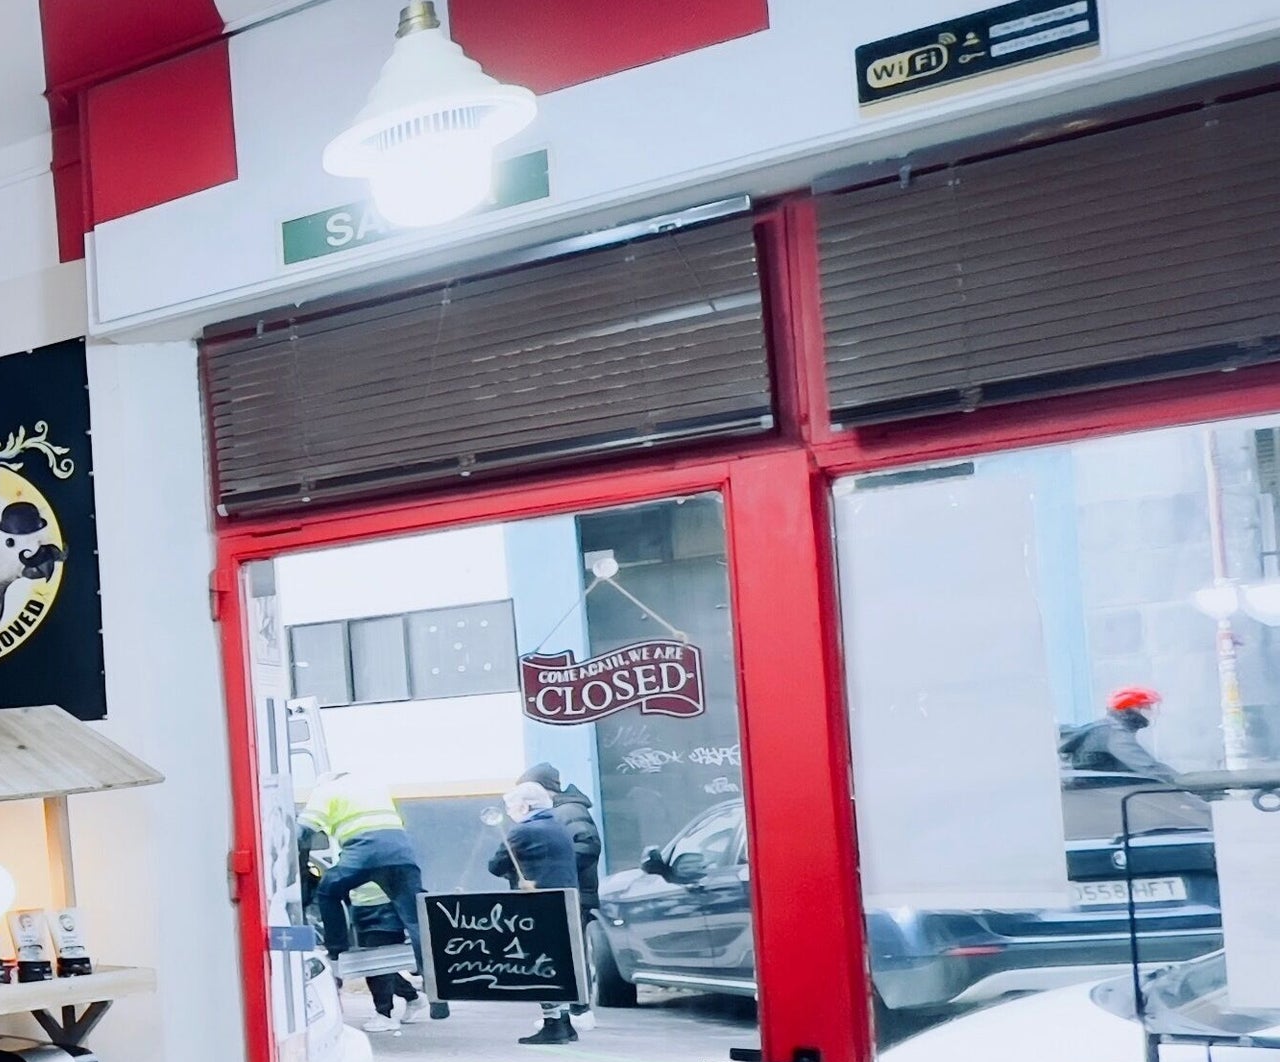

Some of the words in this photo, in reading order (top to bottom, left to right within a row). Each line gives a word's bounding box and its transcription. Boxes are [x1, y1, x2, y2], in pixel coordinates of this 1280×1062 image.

[628, 648, 651, 663] WE
[653, 646, 685, 661] ARE
[536, 662, 687, 716] CLOSED
[1134, 881, 1176, 897] HFT
[436, 901, 535, 934] Vuelvo
[502, 936, 531, 960] 1
[447, 953, 557, 979] minuto
